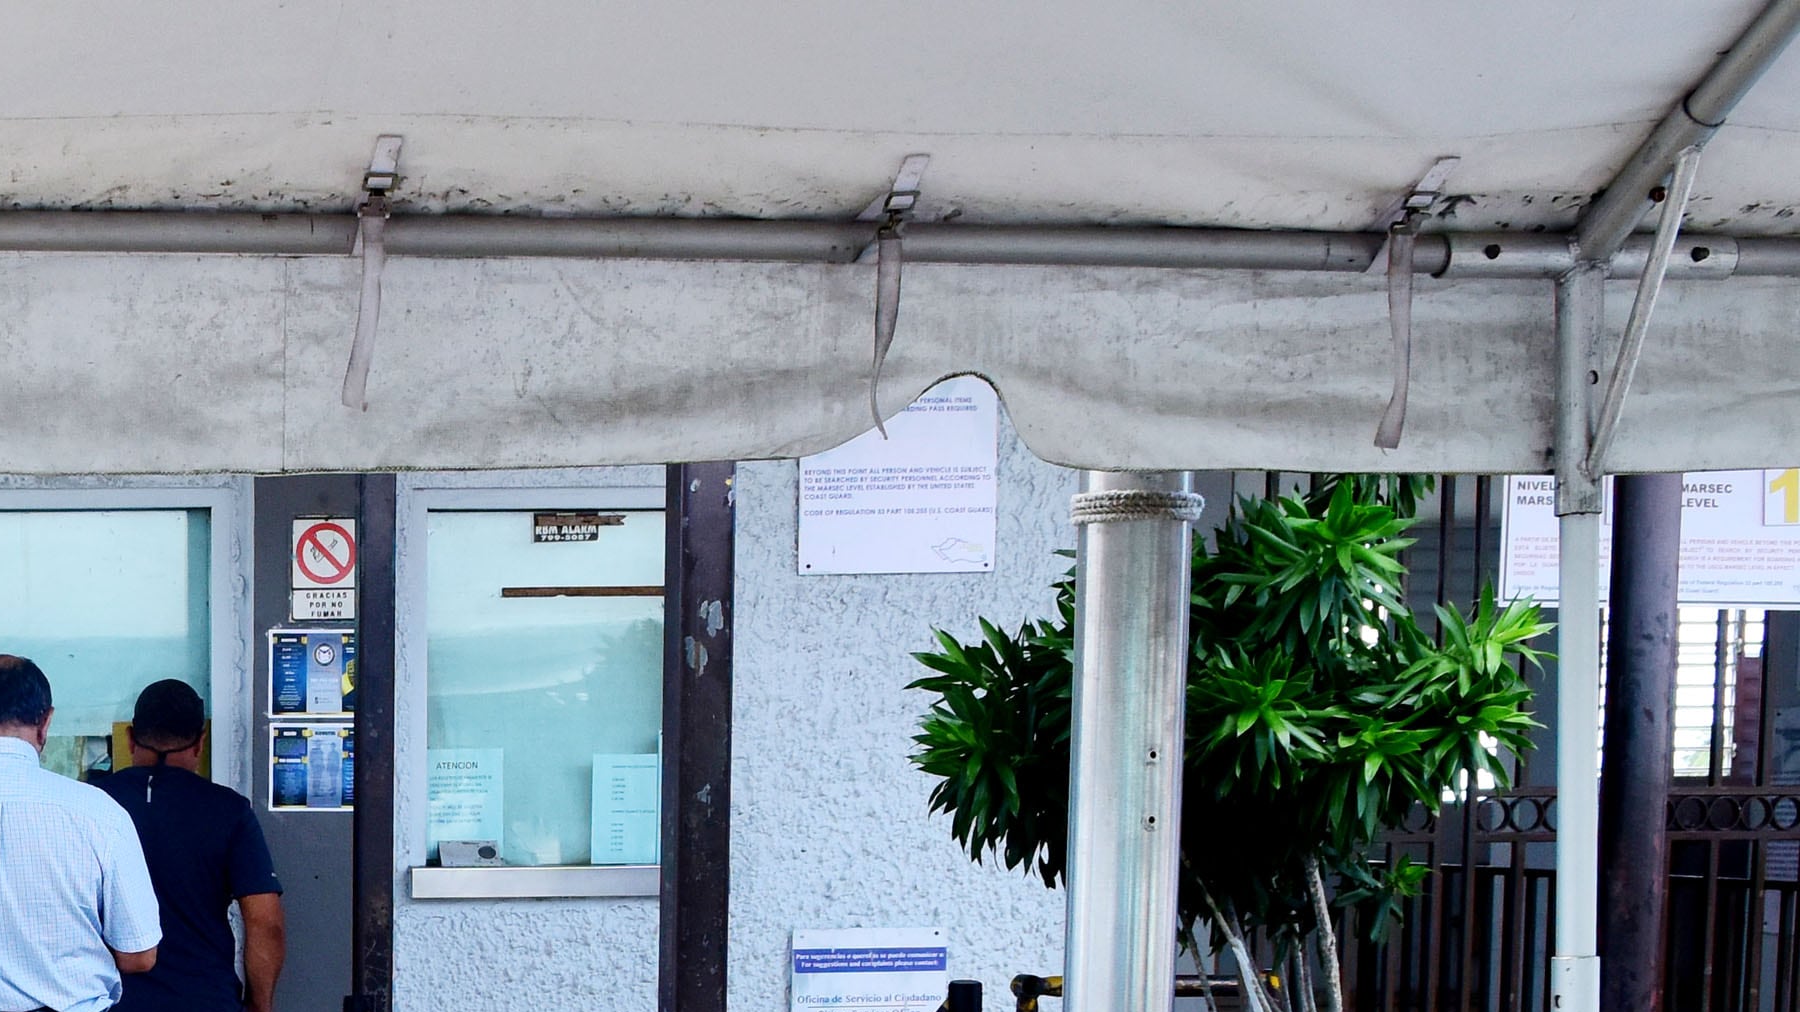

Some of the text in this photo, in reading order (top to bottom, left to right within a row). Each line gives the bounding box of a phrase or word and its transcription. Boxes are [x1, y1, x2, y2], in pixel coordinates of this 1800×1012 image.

[1517, 481, 1556, 491] NIVEL
[1682, 483, 1733, 494] MARSEC
[1769, 468, 1799, 523] 1
[1516, 496, 1553, 506] MARS
[436, 761, 478, 770] ATENCION
[797, 995, 829, 1004] Oficina
[832, 995, 842, 1003] de
[846, 994, 882, 1003] Servicio
